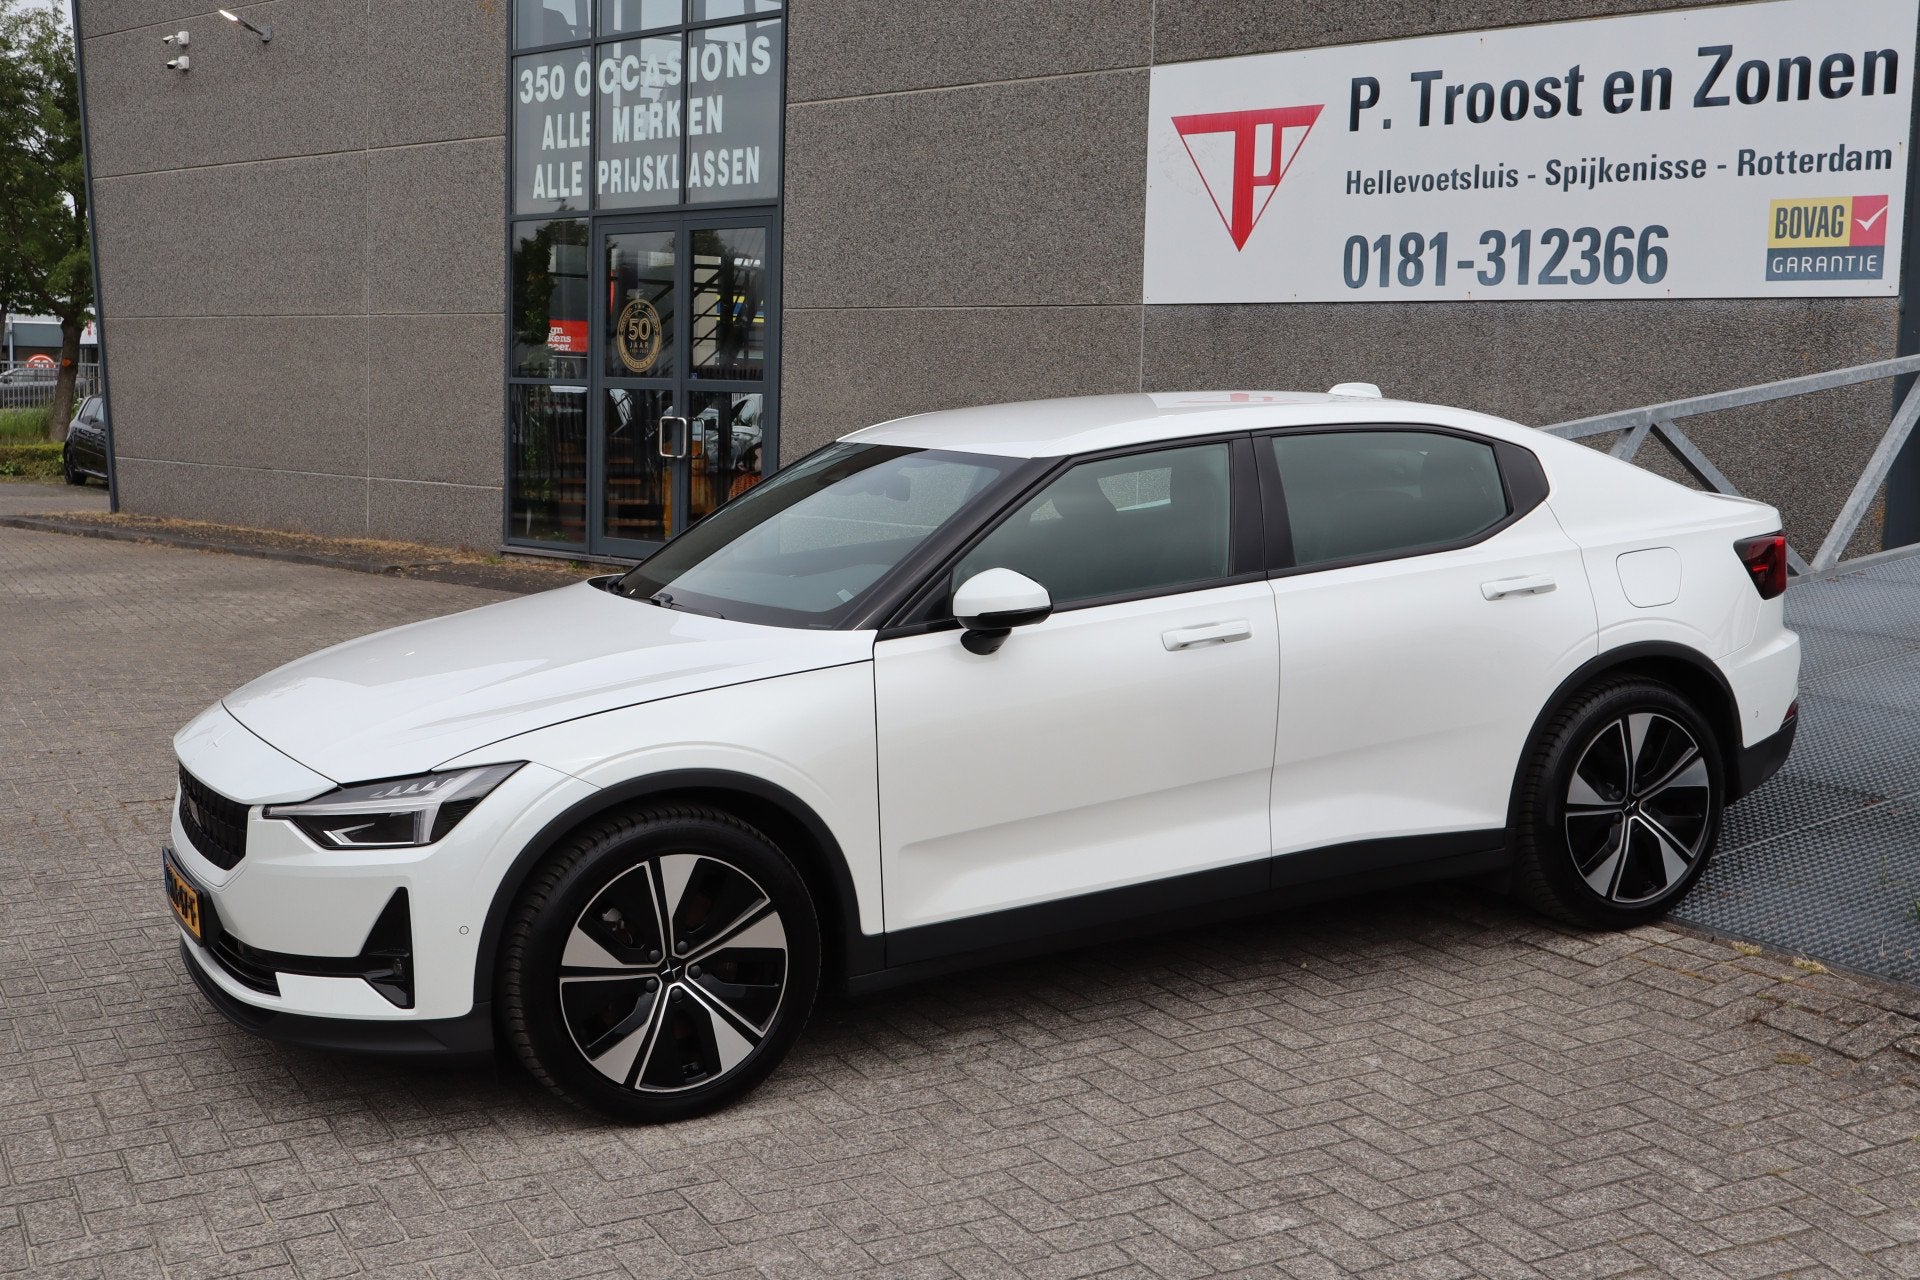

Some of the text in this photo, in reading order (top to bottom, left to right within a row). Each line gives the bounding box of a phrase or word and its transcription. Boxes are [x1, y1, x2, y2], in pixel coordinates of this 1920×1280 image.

[519, 35, 771, 104] 350 OCCASIONS
[1350, 44, 1899, 132] P. Troost en Zonen
[541, 94, 724, 151] ALLE MERKEN
[532, 146, 760, 200] ALLE PRIJSKLASSEN
[1346, 162, 1519, 196] Hellevoetsluis
[1545, 153, 1707, 192] Spijkenisse
[1737, 143, 1892, 177] Rotterdam
[1774, 204, 1845, 239] BOVAG
[1343, 224, 1669, 289] 0181-312366
[1772, 254, 1878, 274] GARANTIE
[628, 317, 651, 341] 50
[629, 341, 649, 349] JAAR
